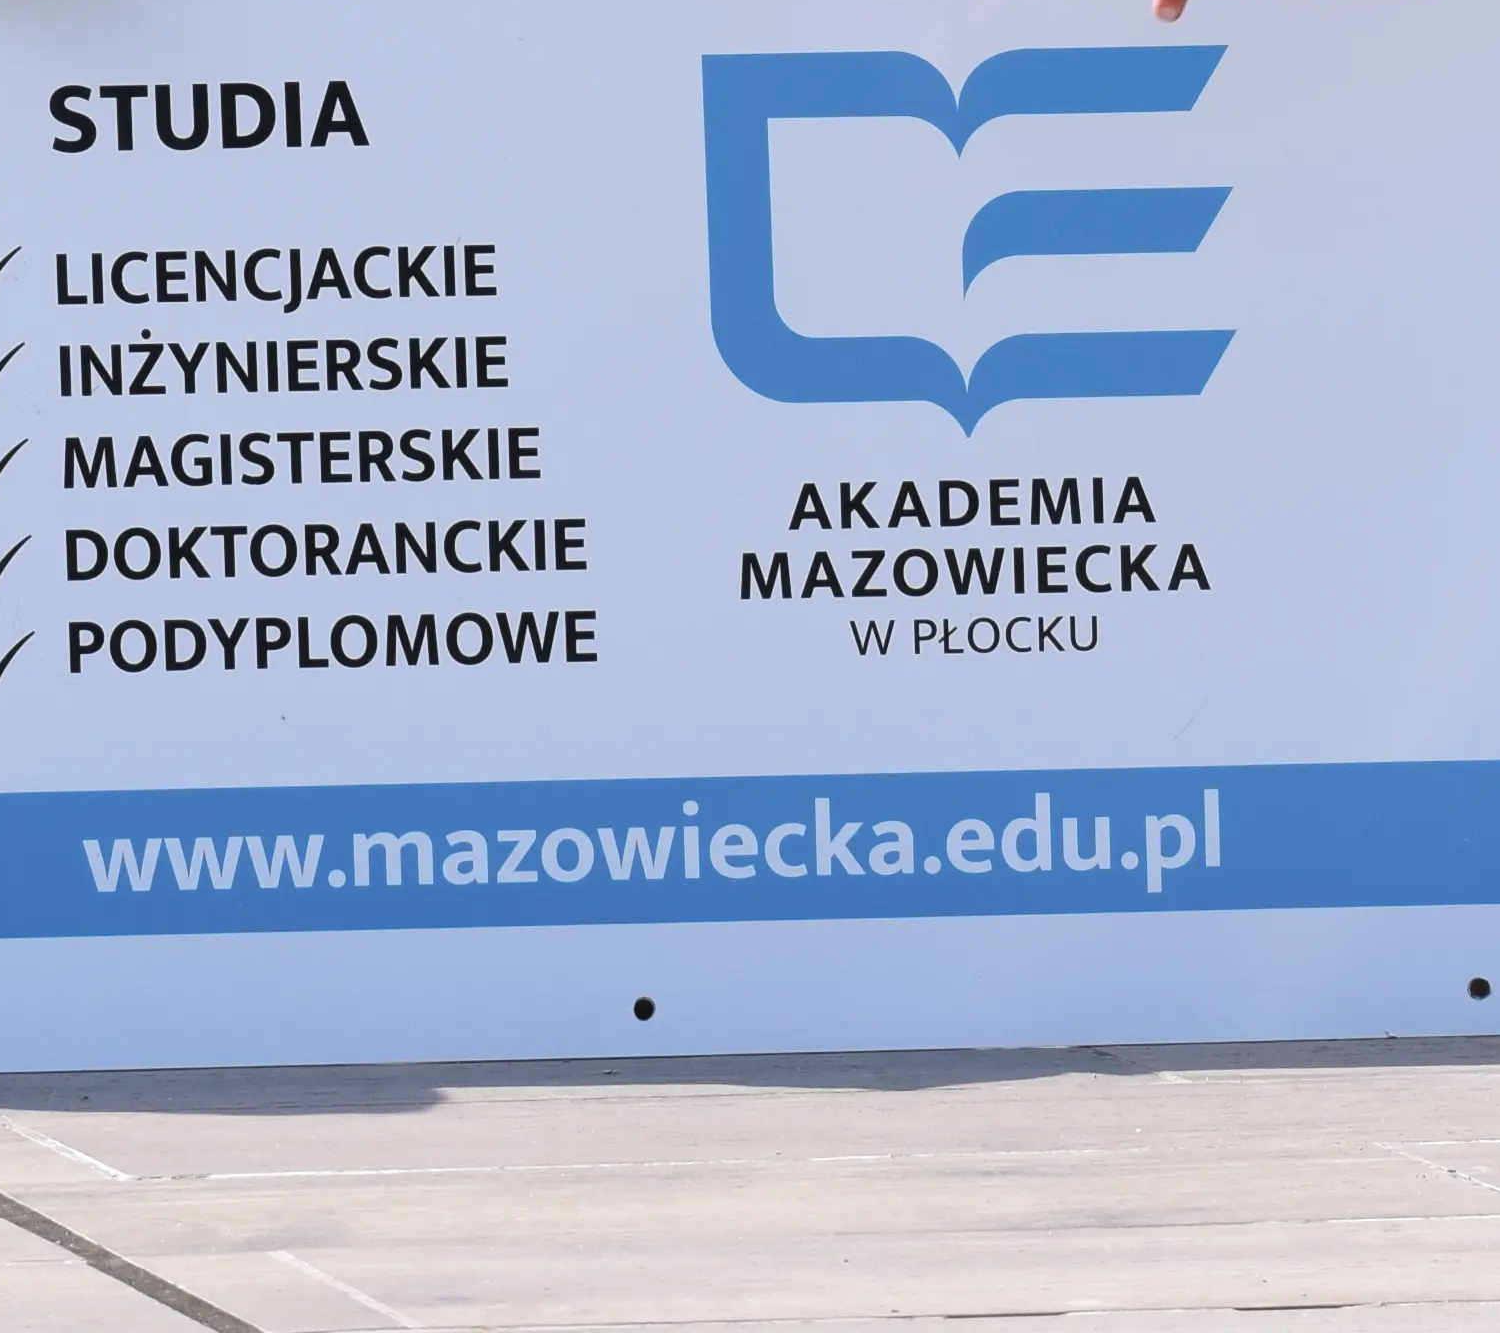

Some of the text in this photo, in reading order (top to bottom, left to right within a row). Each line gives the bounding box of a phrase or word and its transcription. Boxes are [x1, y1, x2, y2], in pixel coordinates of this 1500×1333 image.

[49, 80, 370, 154] STUDIA
[55, 244, 498, 314] LICENCJACKIE
[59, 328, 509, 397] INŻYNIERSKIE
[63, 427, 541, 489] MAGISTERSKIE
[788, 476, 1157, 531] AKADEMIA
[65, 518, 588, 582] DOKTORANCKIE
[740, 543, 1212, 601] MAZOWIECKA
[68, 610, 598, 674] PODYPLOMOWE
[849, 615, 1099, 656] W PŁOCKU
[82, 789, 1223, 894] www.mazowiecka.edu.pl
